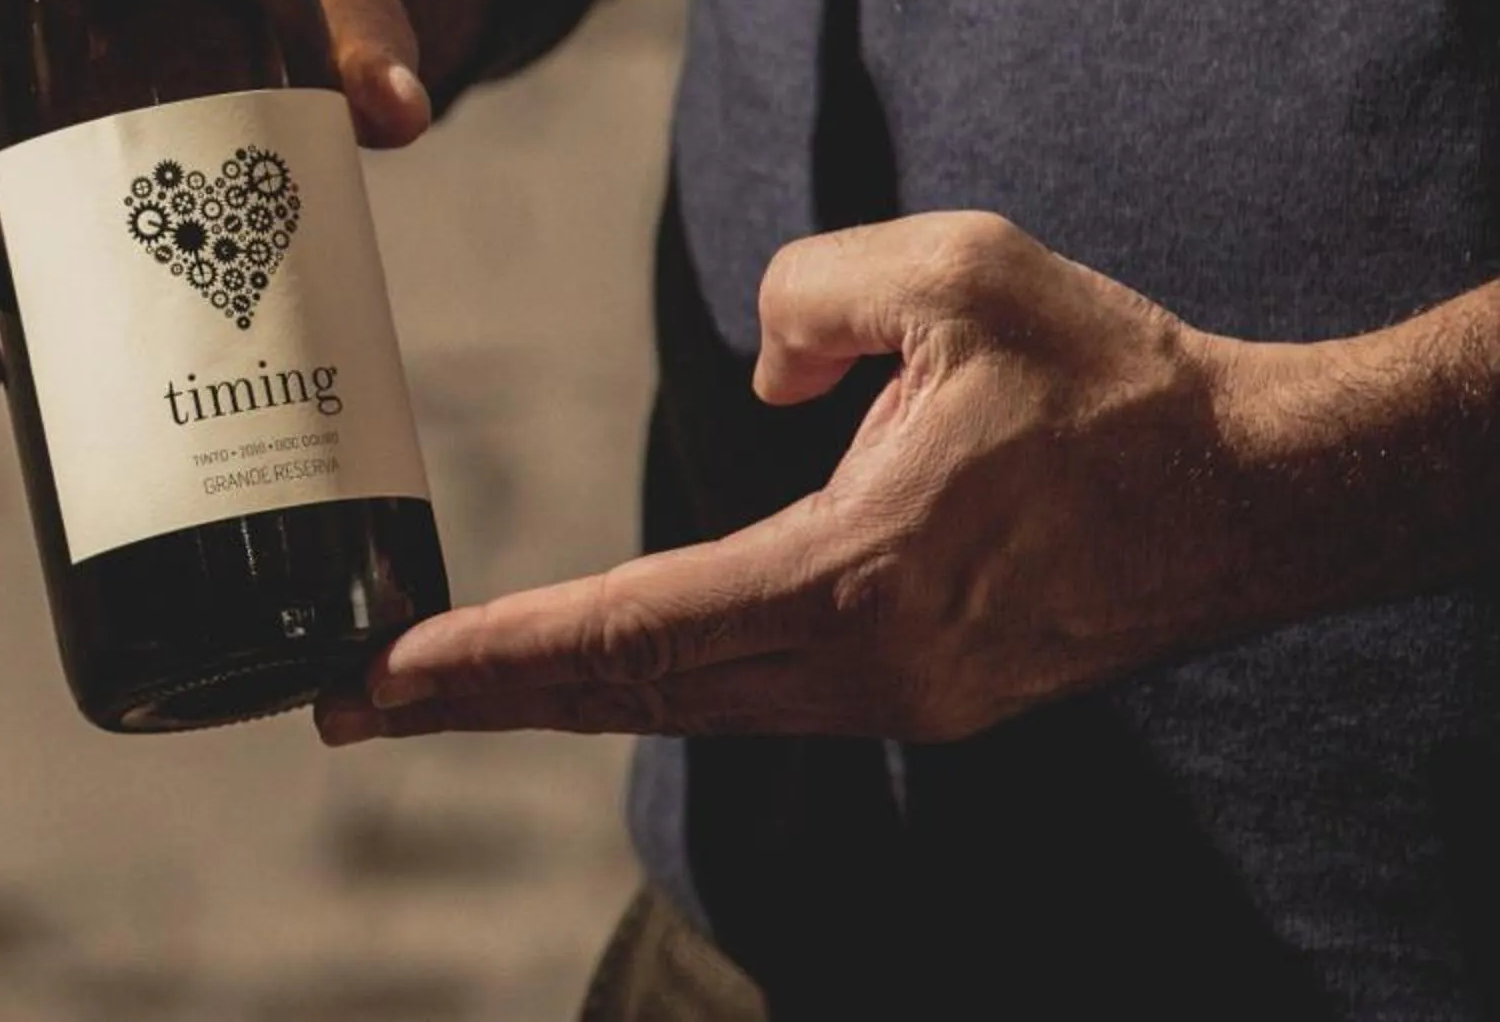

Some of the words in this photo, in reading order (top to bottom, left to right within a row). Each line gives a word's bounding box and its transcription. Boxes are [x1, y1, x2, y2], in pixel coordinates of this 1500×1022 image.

[164, 360, 343, 425] timing
[203, 470, 272, 495] GRANDE
[274, 456, 340, 482] RESERVA
